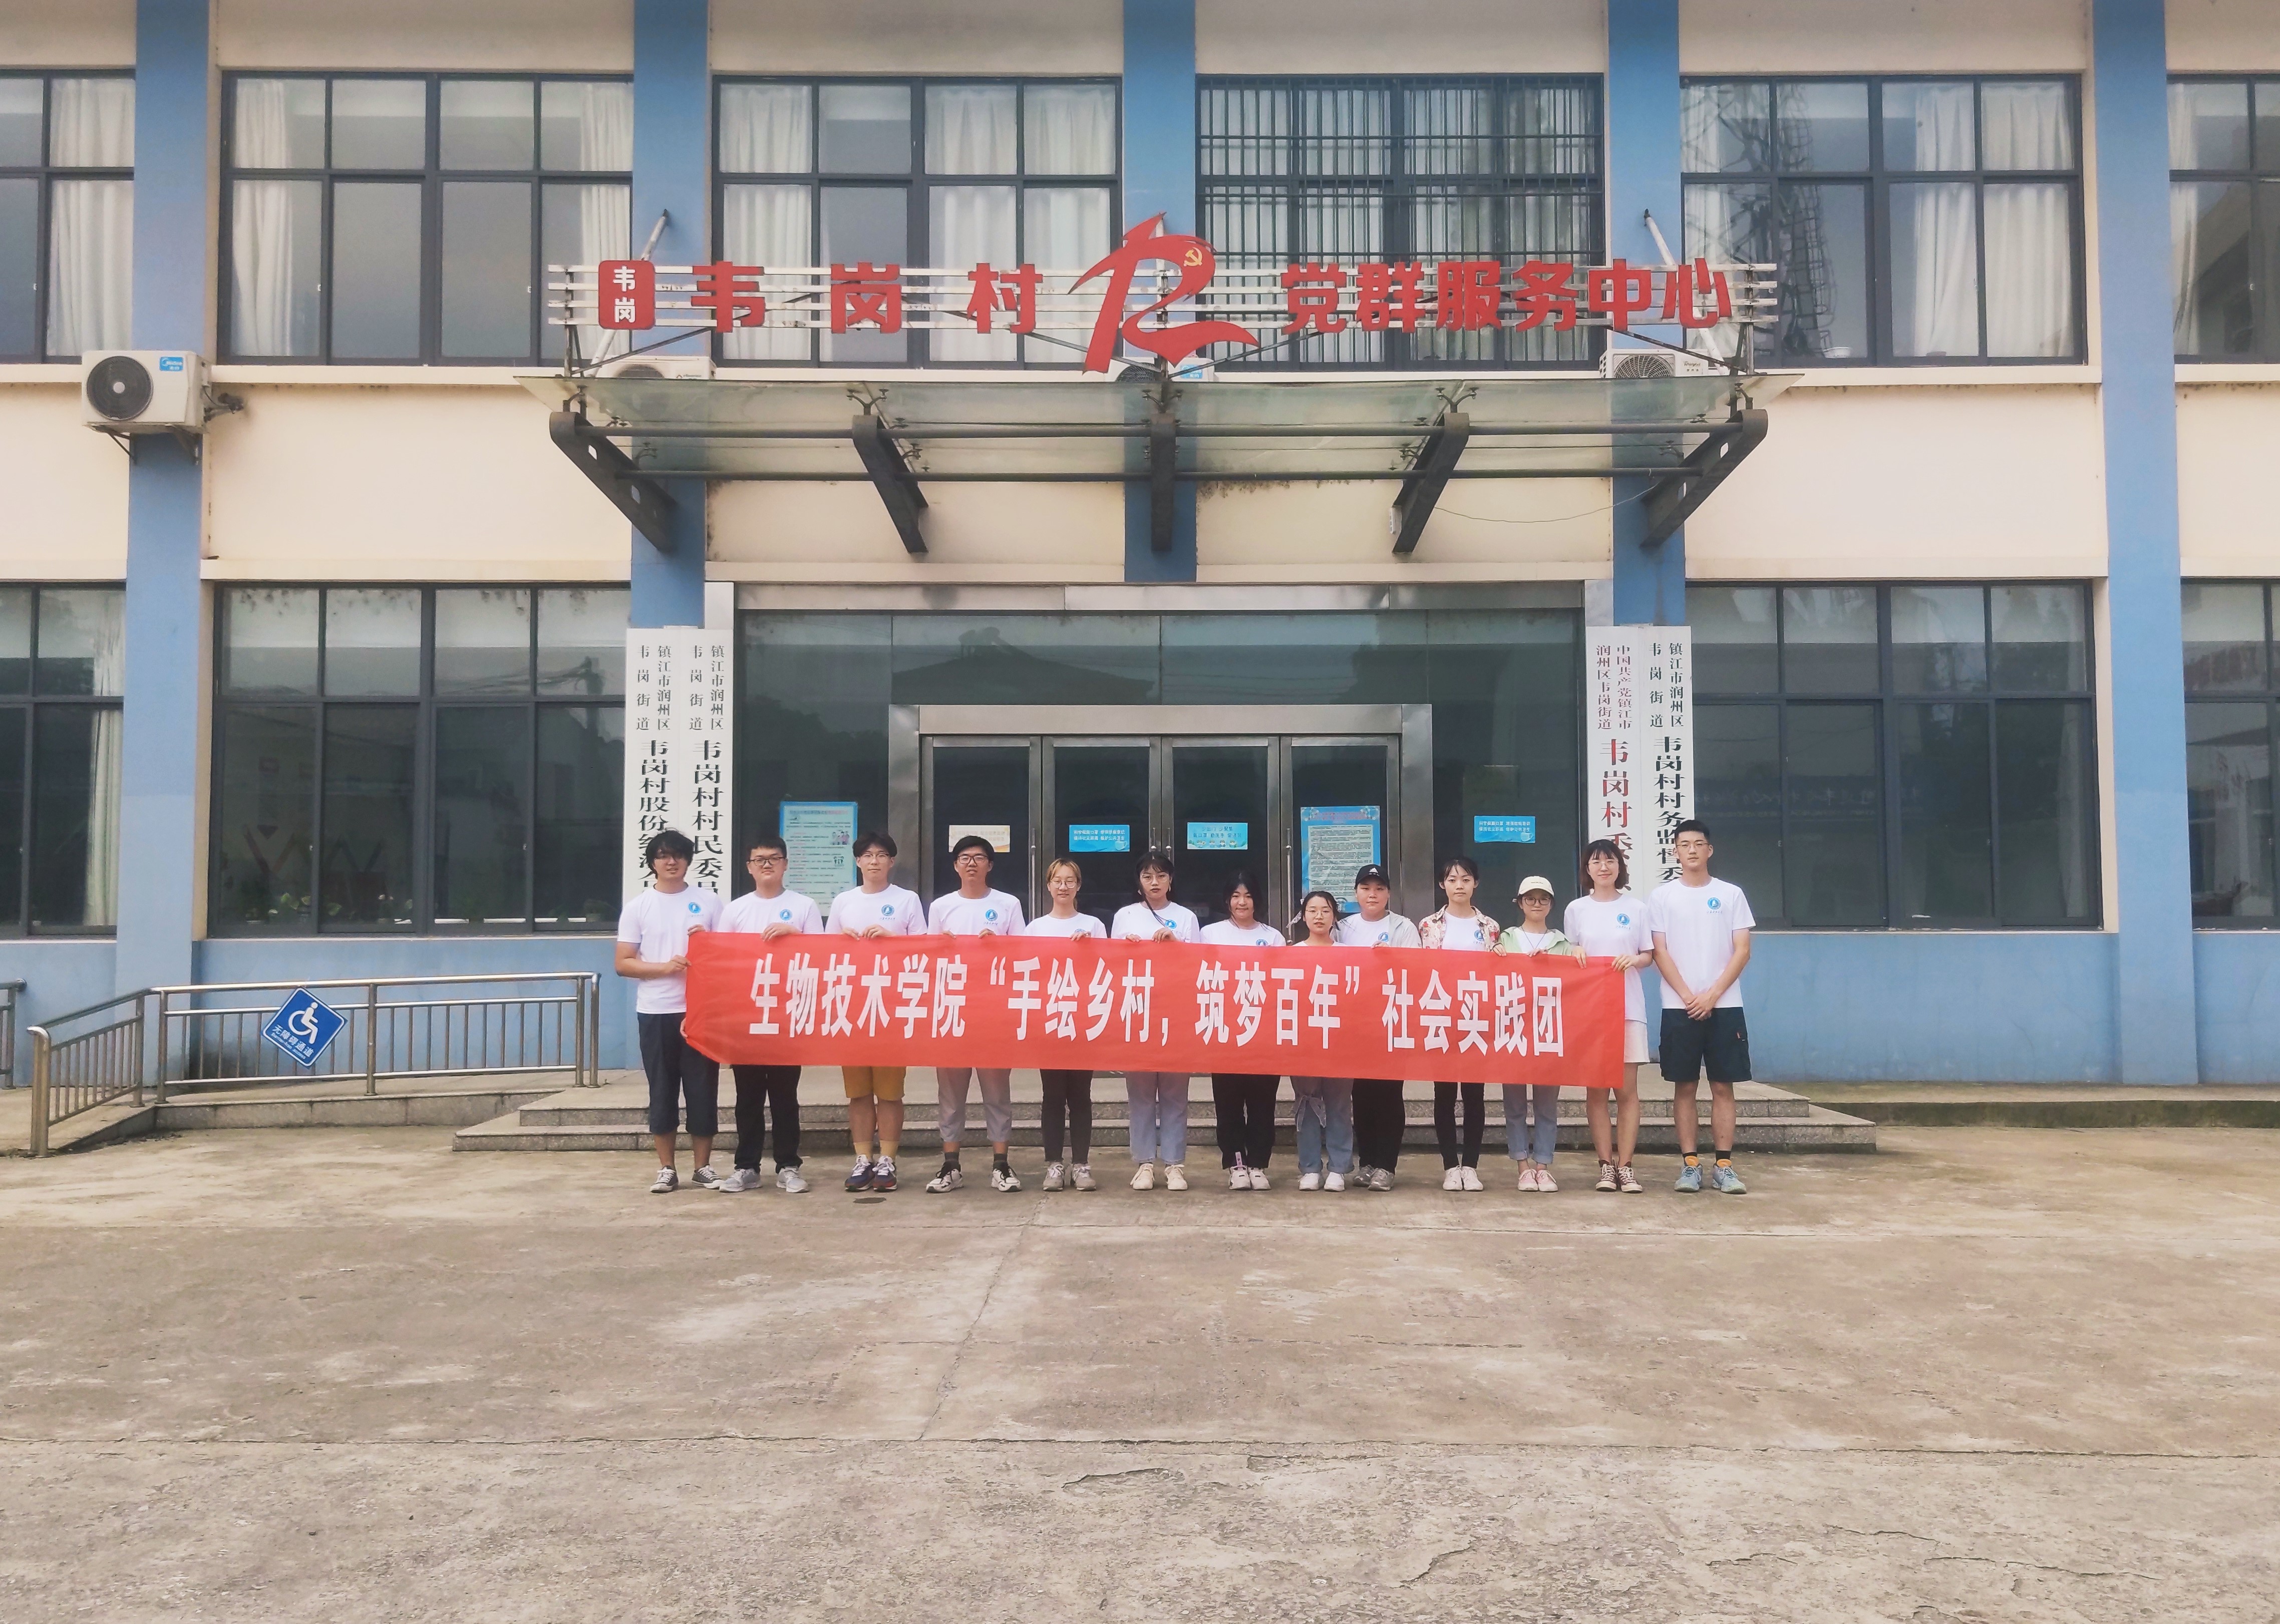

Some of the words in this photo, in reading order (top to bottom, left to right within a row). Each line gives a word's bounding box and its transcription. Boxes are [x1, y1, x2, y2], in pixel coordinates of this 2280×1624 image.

[613, 265, 636, 323] 韦岗
[691, 261, 1042, 334] 韦岗村
[1281, 258, 1732, 335] 党群服务中心
[636, 645, 650, 731] 韦岗街道
[657, 645, 672, 731] 镇江市润州区
[689, 645, 704, 731] 韦岗街道
[711, 645, 725, 731] 镇江市润州区
[1596, 644, 1612, 730] 润州区韦岗街道
[1616, 645, 1633, 730] 中国共产党镇江市
[1649, 642, 1664, 728] 韦岗街道
[1669, 642, 1684, 728] 镇江市润州区
[272, 1024, 314, 1058] 无障碍通道
